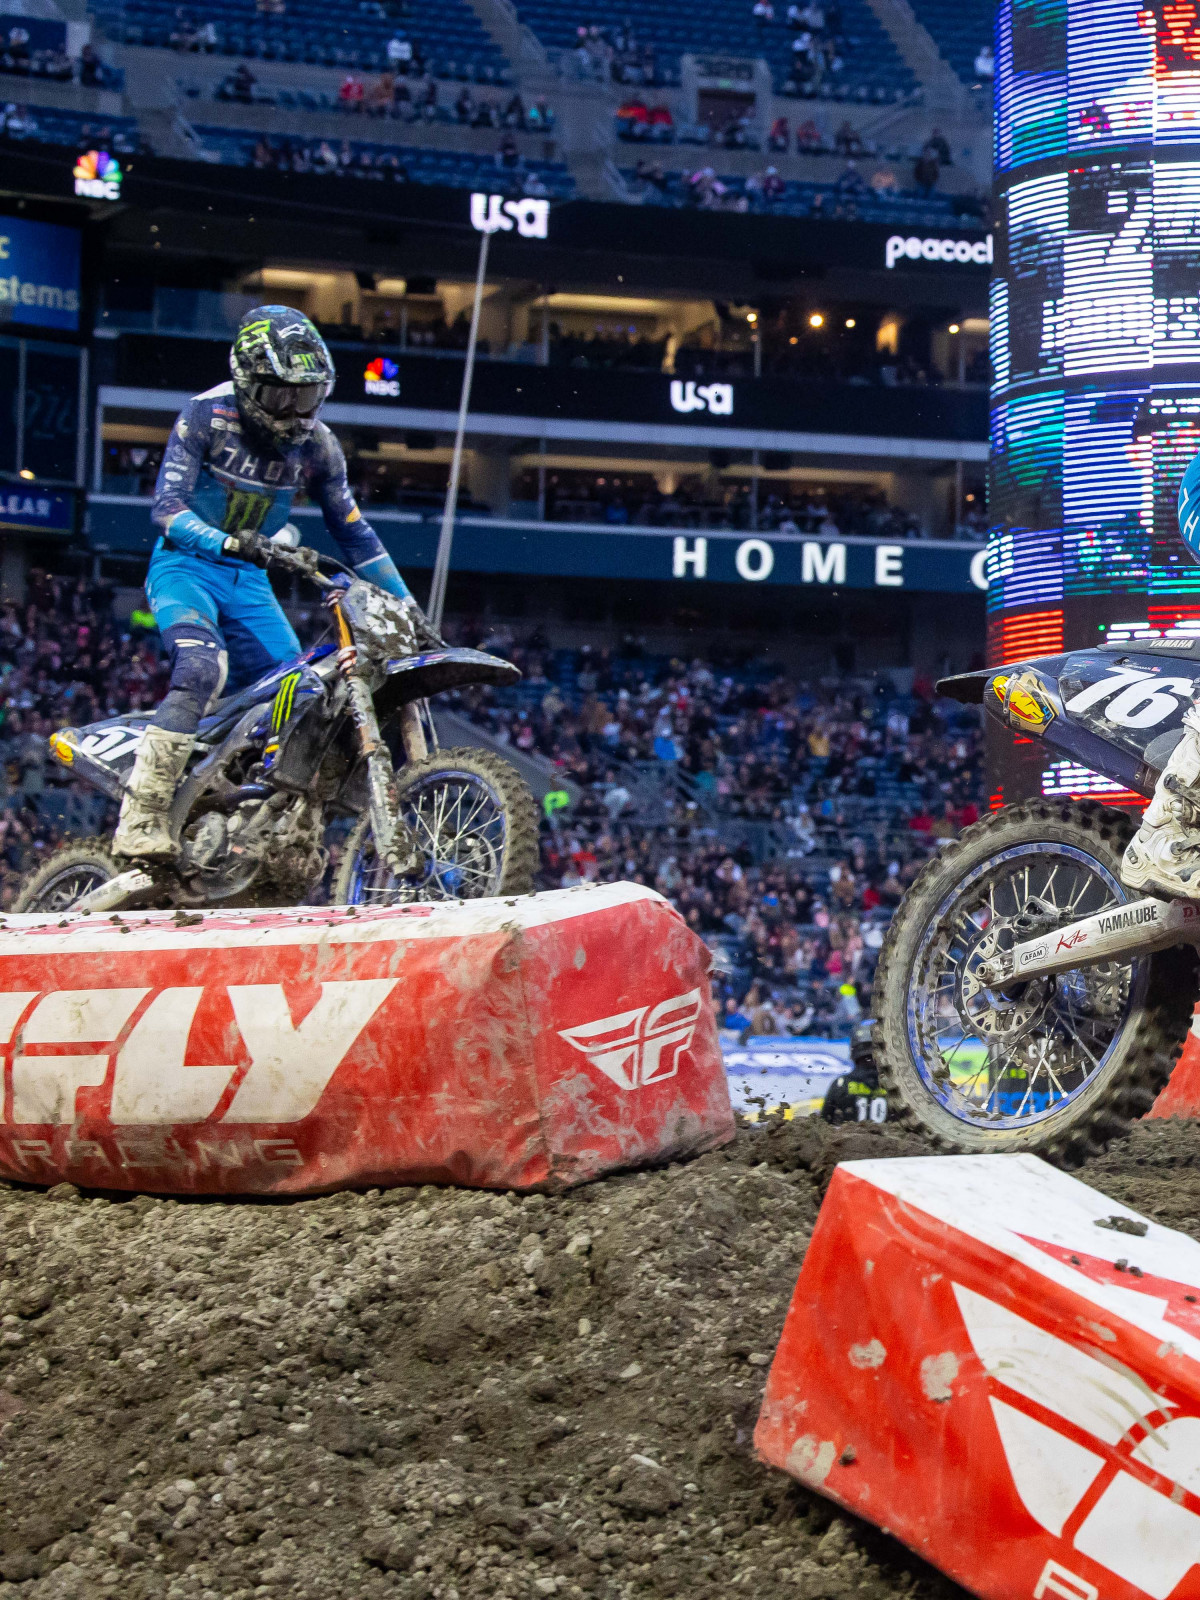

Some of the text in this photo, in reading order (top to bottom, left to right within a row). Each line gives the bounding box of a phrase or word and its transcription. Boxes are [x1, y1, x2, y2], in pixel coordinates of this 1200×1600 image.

[672, 536, 904, 586] HOME
[1149, 639, 1195, 648] YAMAHA
[1064, 666, 1195, 729] 76
[1098, 905, 1158, 935] YAMALUBE
[1024, 950, 1043, 962] AFAM
[1055, 929, 1088, 954] Kite
[11, 1138, 305, 1169] RACING
